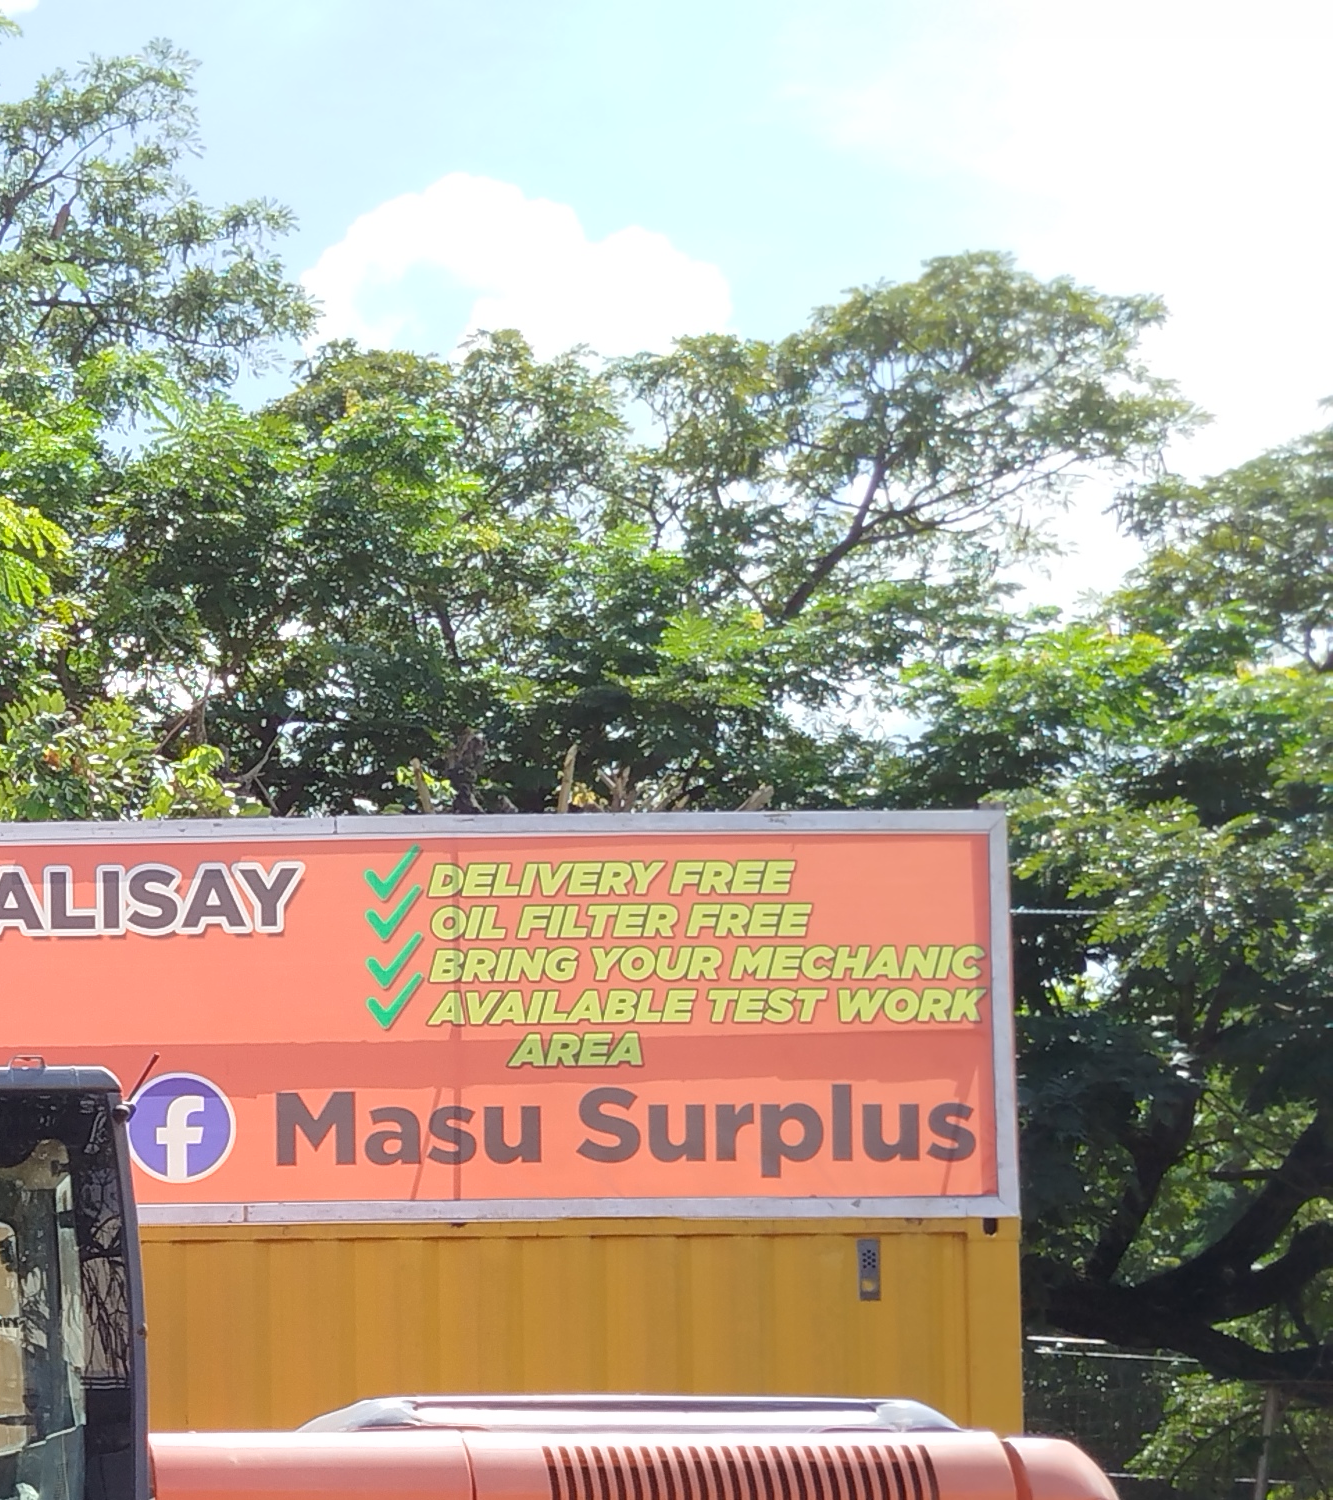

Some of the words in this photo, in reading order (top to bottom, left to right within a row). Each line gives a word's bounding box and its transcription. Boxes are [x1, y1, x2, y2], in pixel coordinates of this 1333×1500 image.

[427, 861, 666, 898] DELIVERY
[669, 860, 796, 895] FREE
[430, 904, 506, 940] OIL
[516, 903, 679, 939] FILTER
[685, 902, 812, 938] FREE
[428, 946, 579, 983] BRING
[591, 945, 723, 981] YOUR
[729, 943, 985, 981] MECHANIC
[426, 988, 698, 1025] AVAILABLE
[707, 987, 828, 1024] TEST
[836, 986, 986, 1024] WORK
[506, 1031, 645, 1068] AREA
[275, 1091, 542, 1166] Masu
[576, 1083, 977, 1178] Surplus
